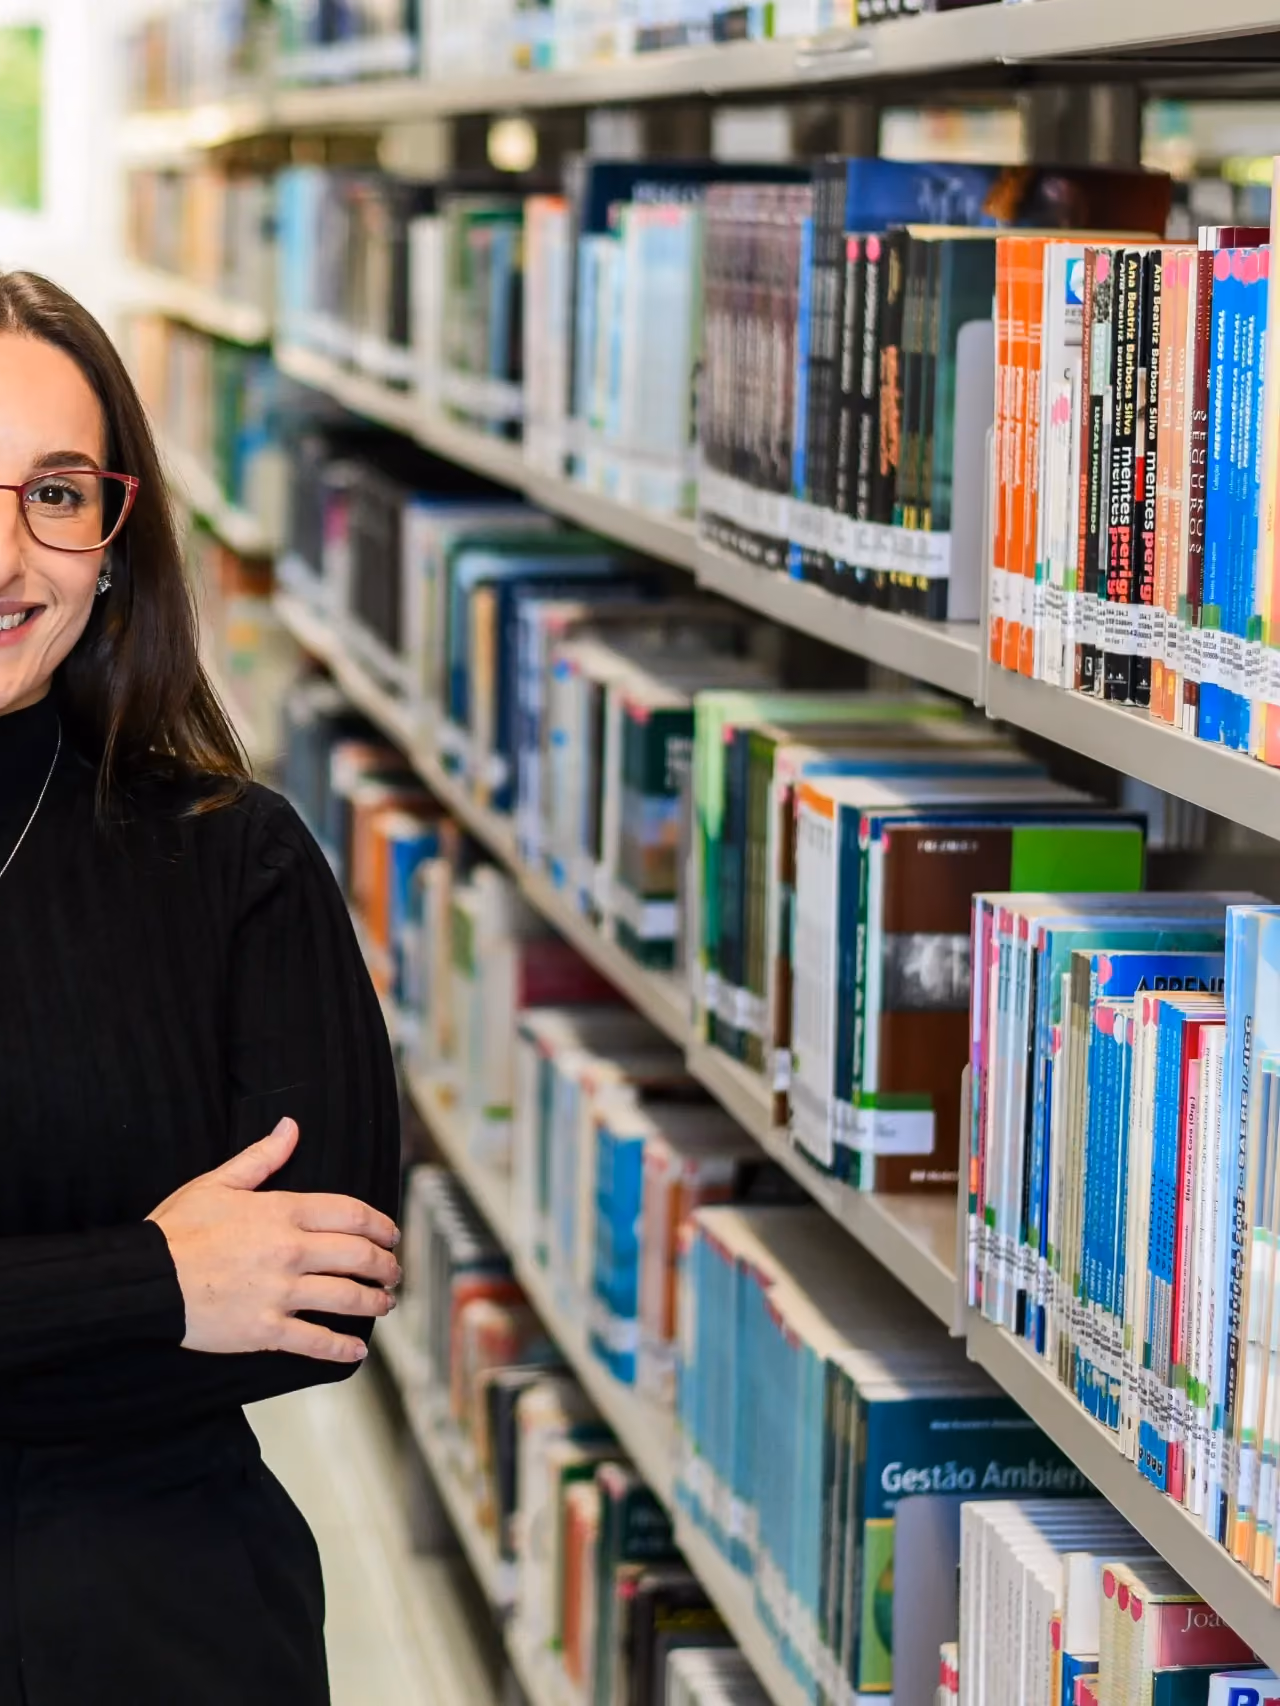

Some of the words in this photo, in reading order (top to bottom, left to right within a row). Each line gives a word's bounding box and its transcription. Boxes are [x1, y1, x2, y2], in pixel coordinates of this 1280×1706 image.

[1128, 259, 1138, 288] Ana
[1153, 263, 1163, 292] Ana
[1126, 291, 1137, 341] Beatriz
[1151, 296, 1161, 344] Beatriz
[1216, 309, 1226, 361] SOCIAL
[1247, 314, 1255, 366] SOCIAL
[1125, 343, 1136, 399] Barbosa
[1150, 348, 1160, 404] Barbosa
[1092, 405, 1100, 450] LUCAS
[1123, 402, 1134, 436] Silva
[1148, 407, 1157, 441] Silva
[1213, 364, 1224, 461] PREVIDÊNCIA
[1090, 453, 1099, 535] FIGUEIREDO
[1120, 446, 1133, 525] mentes
[1144, 450, 1157, 531] mentes
[1139, 531, 1156, 605] perig
[880, 1461, 976, 1493] Gestão
[980, 1458, 1092, 1489] Ambien
